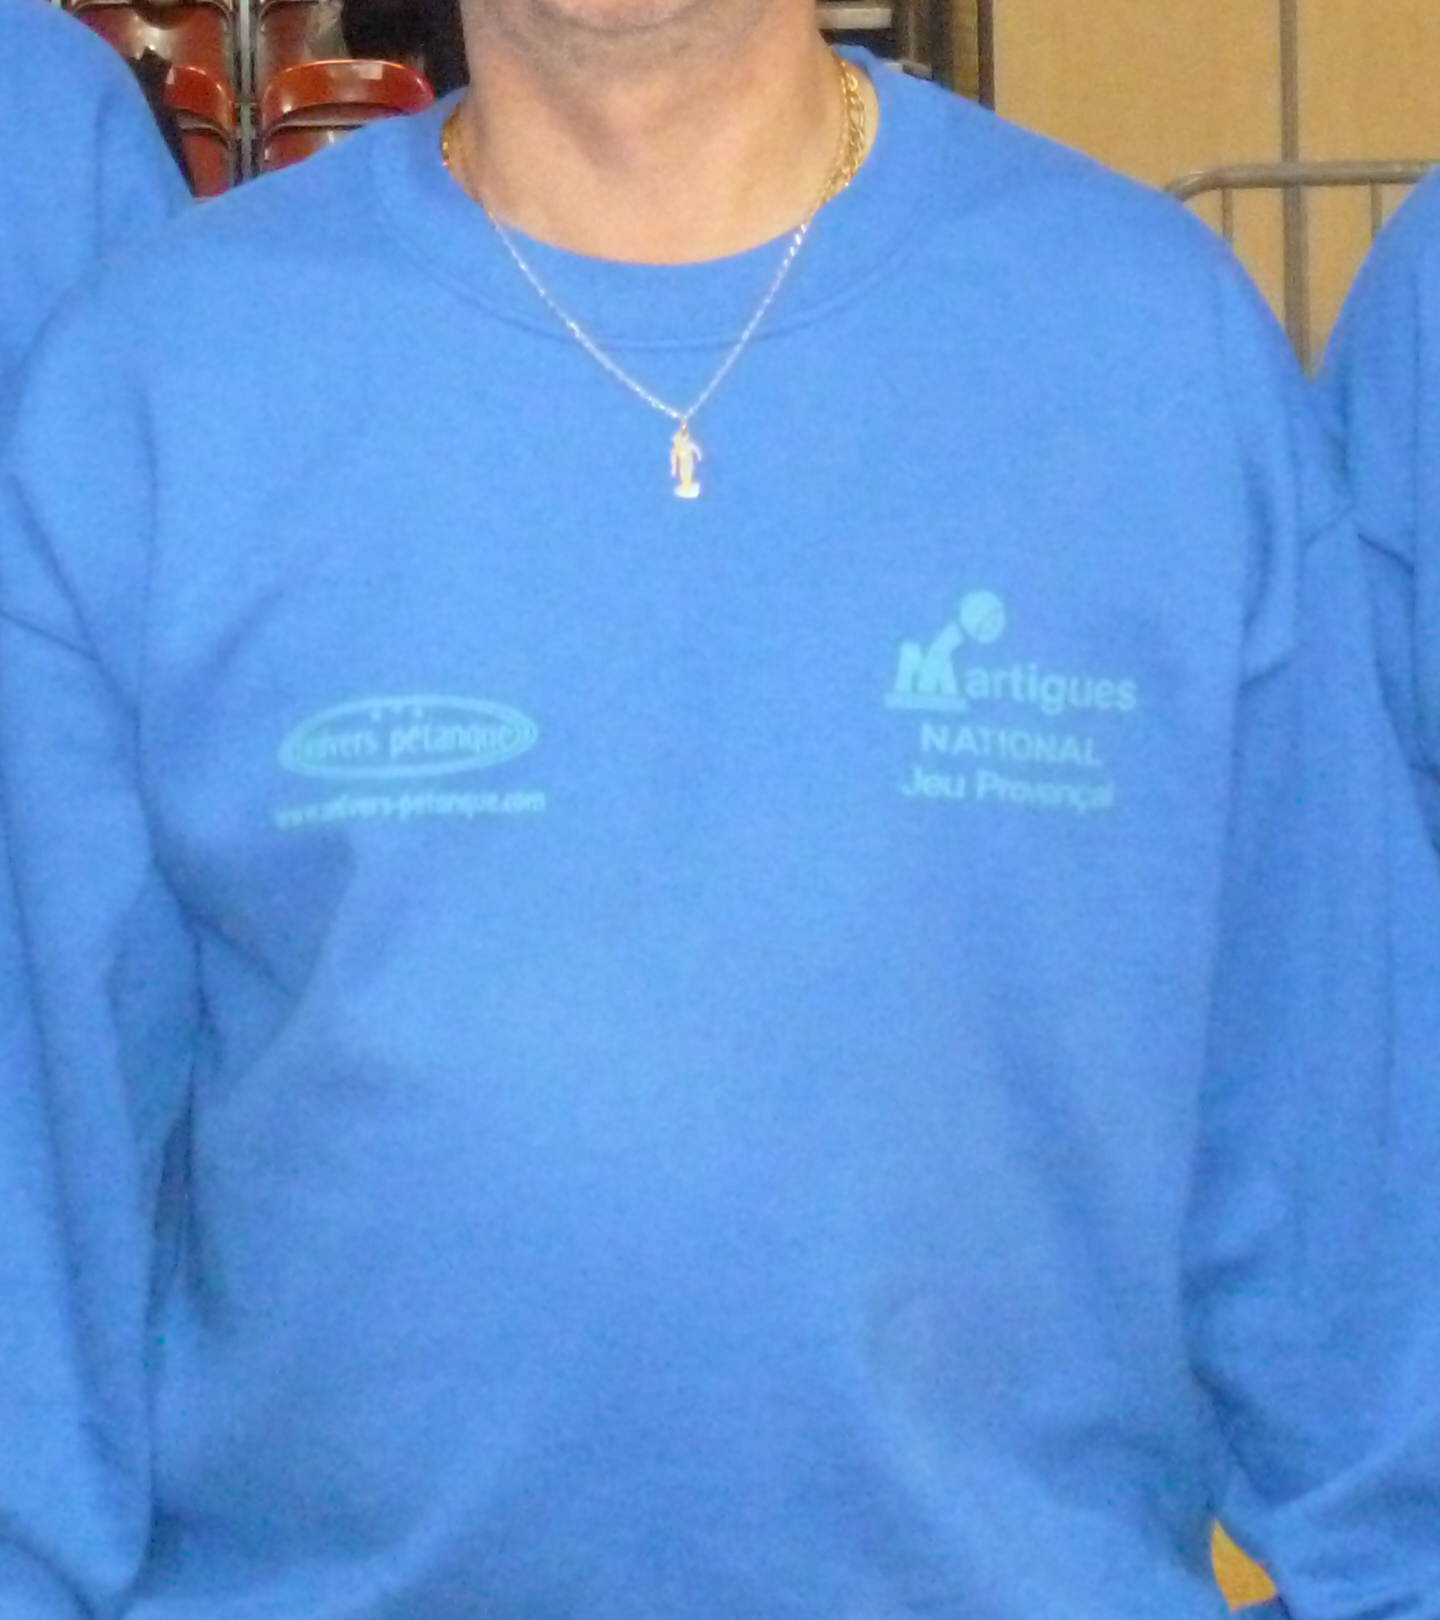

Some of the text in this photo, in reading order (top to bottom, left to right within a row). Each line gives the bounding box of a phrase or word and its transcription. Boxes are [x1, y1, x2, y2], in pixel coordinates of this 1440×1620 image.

[893, 623, 1137, 715] Martigues
[920, 721, 1103, 770] NATIONAL
[899, 764, 965, 800] Jeu
